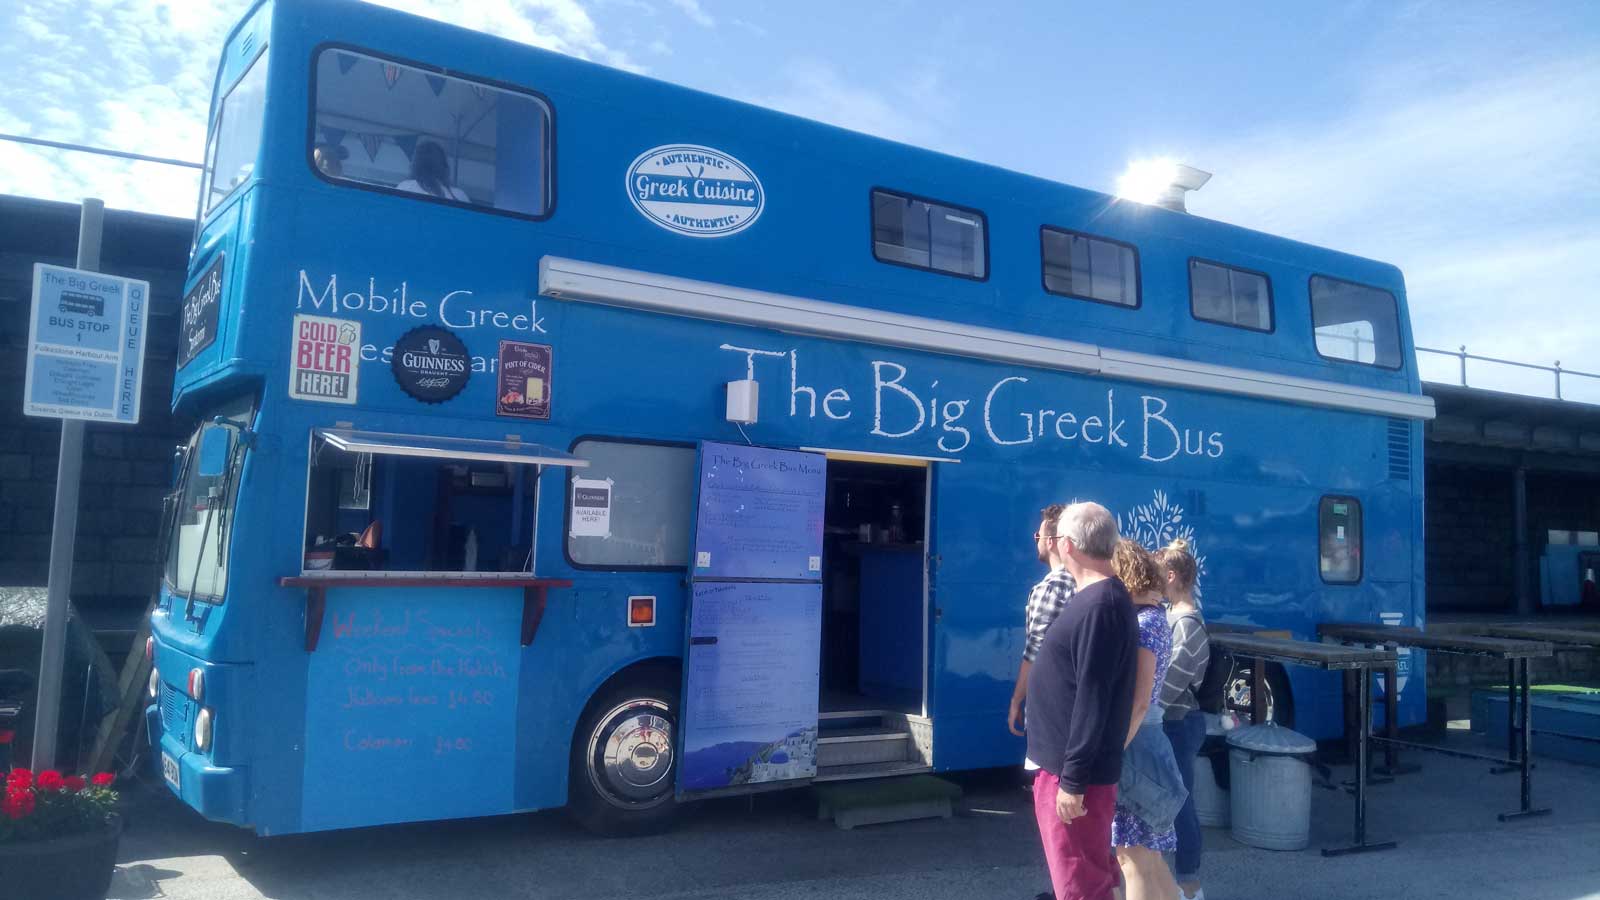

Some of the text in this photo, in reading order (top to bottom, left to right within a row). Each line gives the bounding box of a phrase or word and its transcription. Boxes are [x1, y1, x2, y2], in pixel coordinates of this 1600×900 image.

[661, 153, 724, 170] AUTHENTIC
[636, 174, 755, 202] Greek Cuisine
[672, 214, 735, 229] AUTHENTIC
[44, 272, 120, 295] The Big Greek
[295, 269, 548, 335] Mobile Greek
[48, 316, 110, 334] BUS STOP
[299, 320, 338, 344] COLD
[76, 332, 81, 343] 1
[121, 288, 141, 415] QUEUE HERE
[296, 340, 352, 375] BEER
[402, 352, 465, 372] GUINNESS
[504, 360, 519, 371] PINT
[519, 360, 528, 369] OF
[527, 361, 546, 375] CIDER
[300, 372, 345, 397] HERE!
[719, 343, 1224, 463] The Big Greek Bus
